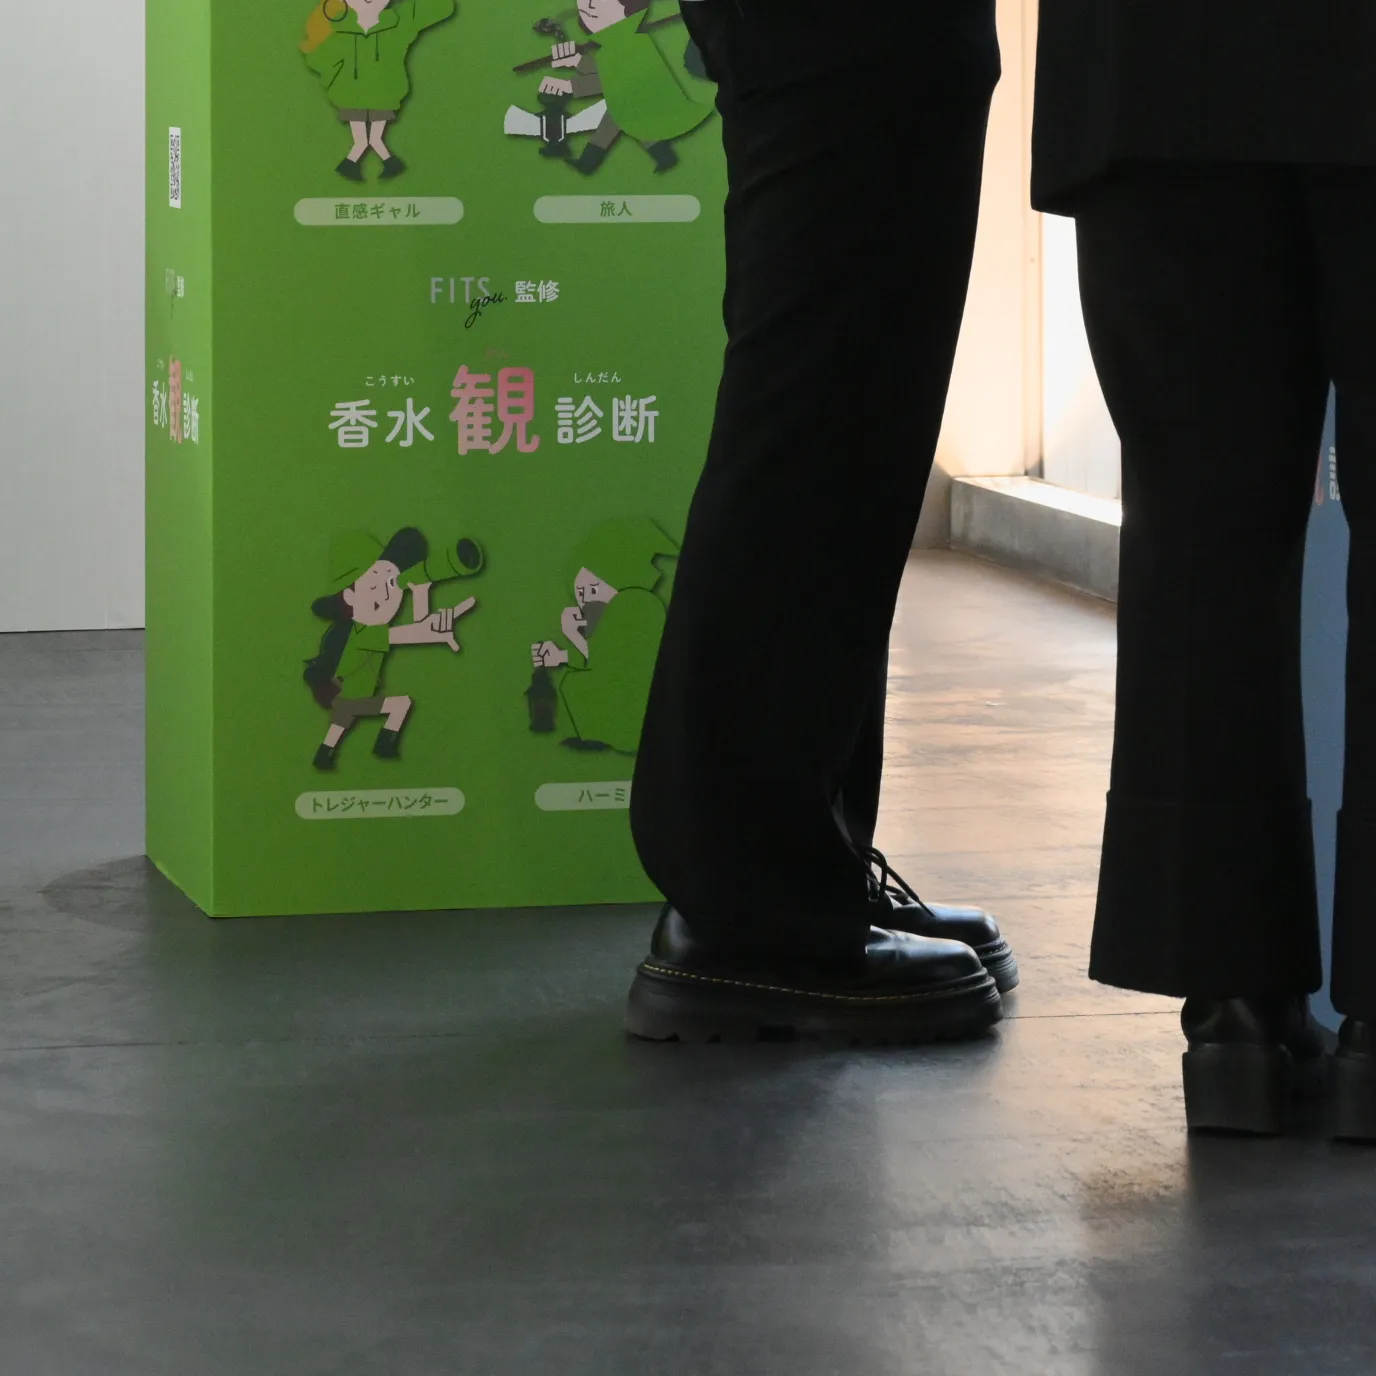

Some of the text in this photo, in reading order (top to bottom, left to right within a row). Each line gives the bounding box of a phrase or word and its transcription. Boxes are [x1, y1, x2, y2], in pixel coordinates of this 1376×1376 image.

[334, 202, 421, 221] 直感ギャル
[599, 200, 633, 218] 旅人
[430, 276, 491, 305] FITS
[515, 280, 561, 304] 監修
[364, 374, 415, 387] こうすい
[574, 371, 622, 384] しんだん
[312, 793, 449, 813] トレジャーハンター
